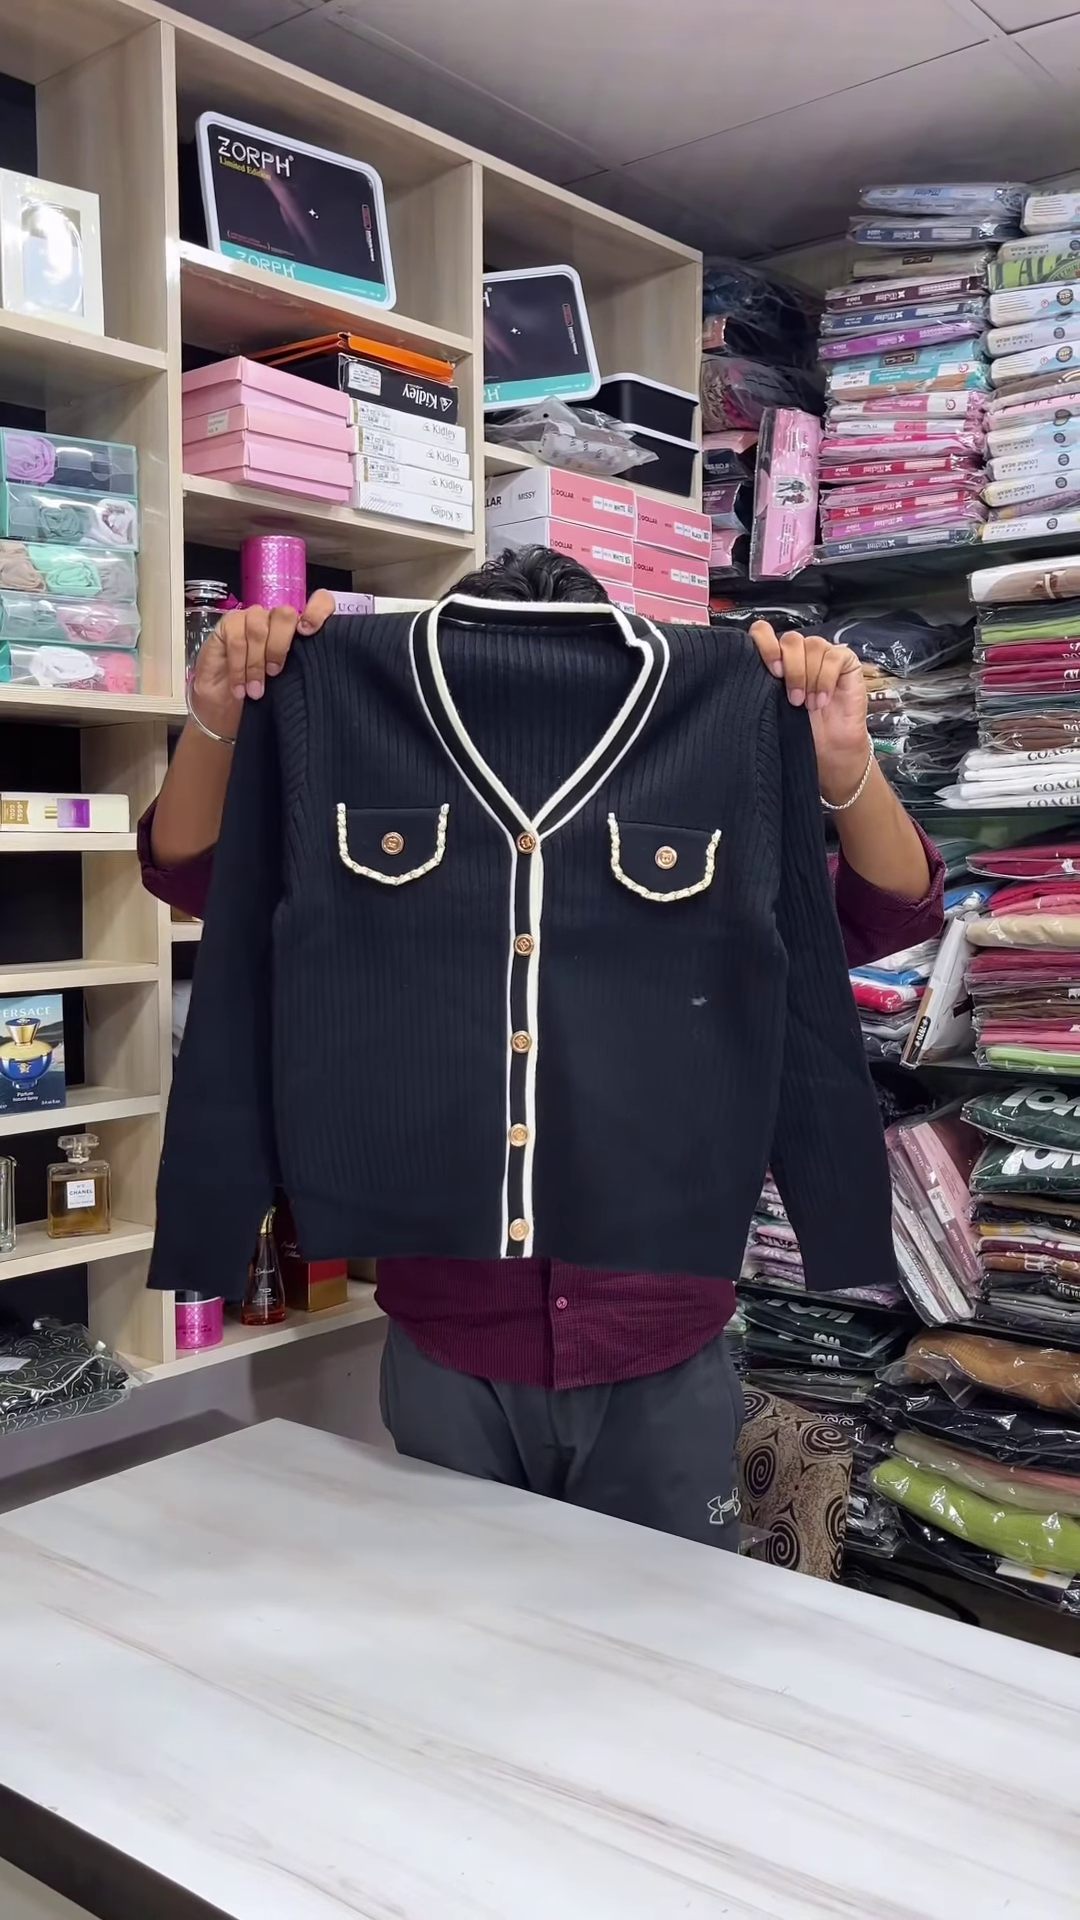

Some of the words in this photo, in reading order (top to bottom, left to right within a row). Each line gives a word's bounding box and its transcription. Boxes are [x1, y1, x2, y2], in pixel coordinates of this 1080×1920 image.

[218, 136, 291, 178] ZORPH
[219, 157, 246, 173] Limited
[402, 384, 438, 410] Kidley
[432, 423, 456, 440] Kidley
[436, 450, 460, 467] Kidley
[440, 476, 464, 494] Kidley
[518, 490, 536, 501] MISSY
[556, 489, 574, 499] DOLLAR
[431, 504, 454, 520] Kidley
[642, 514, 658, 524] DOLLAR
[554, 540, 573, 550] DOLLAR
[638, 563, 654, 572] DOLLAR
[0, 1006, 52, 1018] ERSACE
